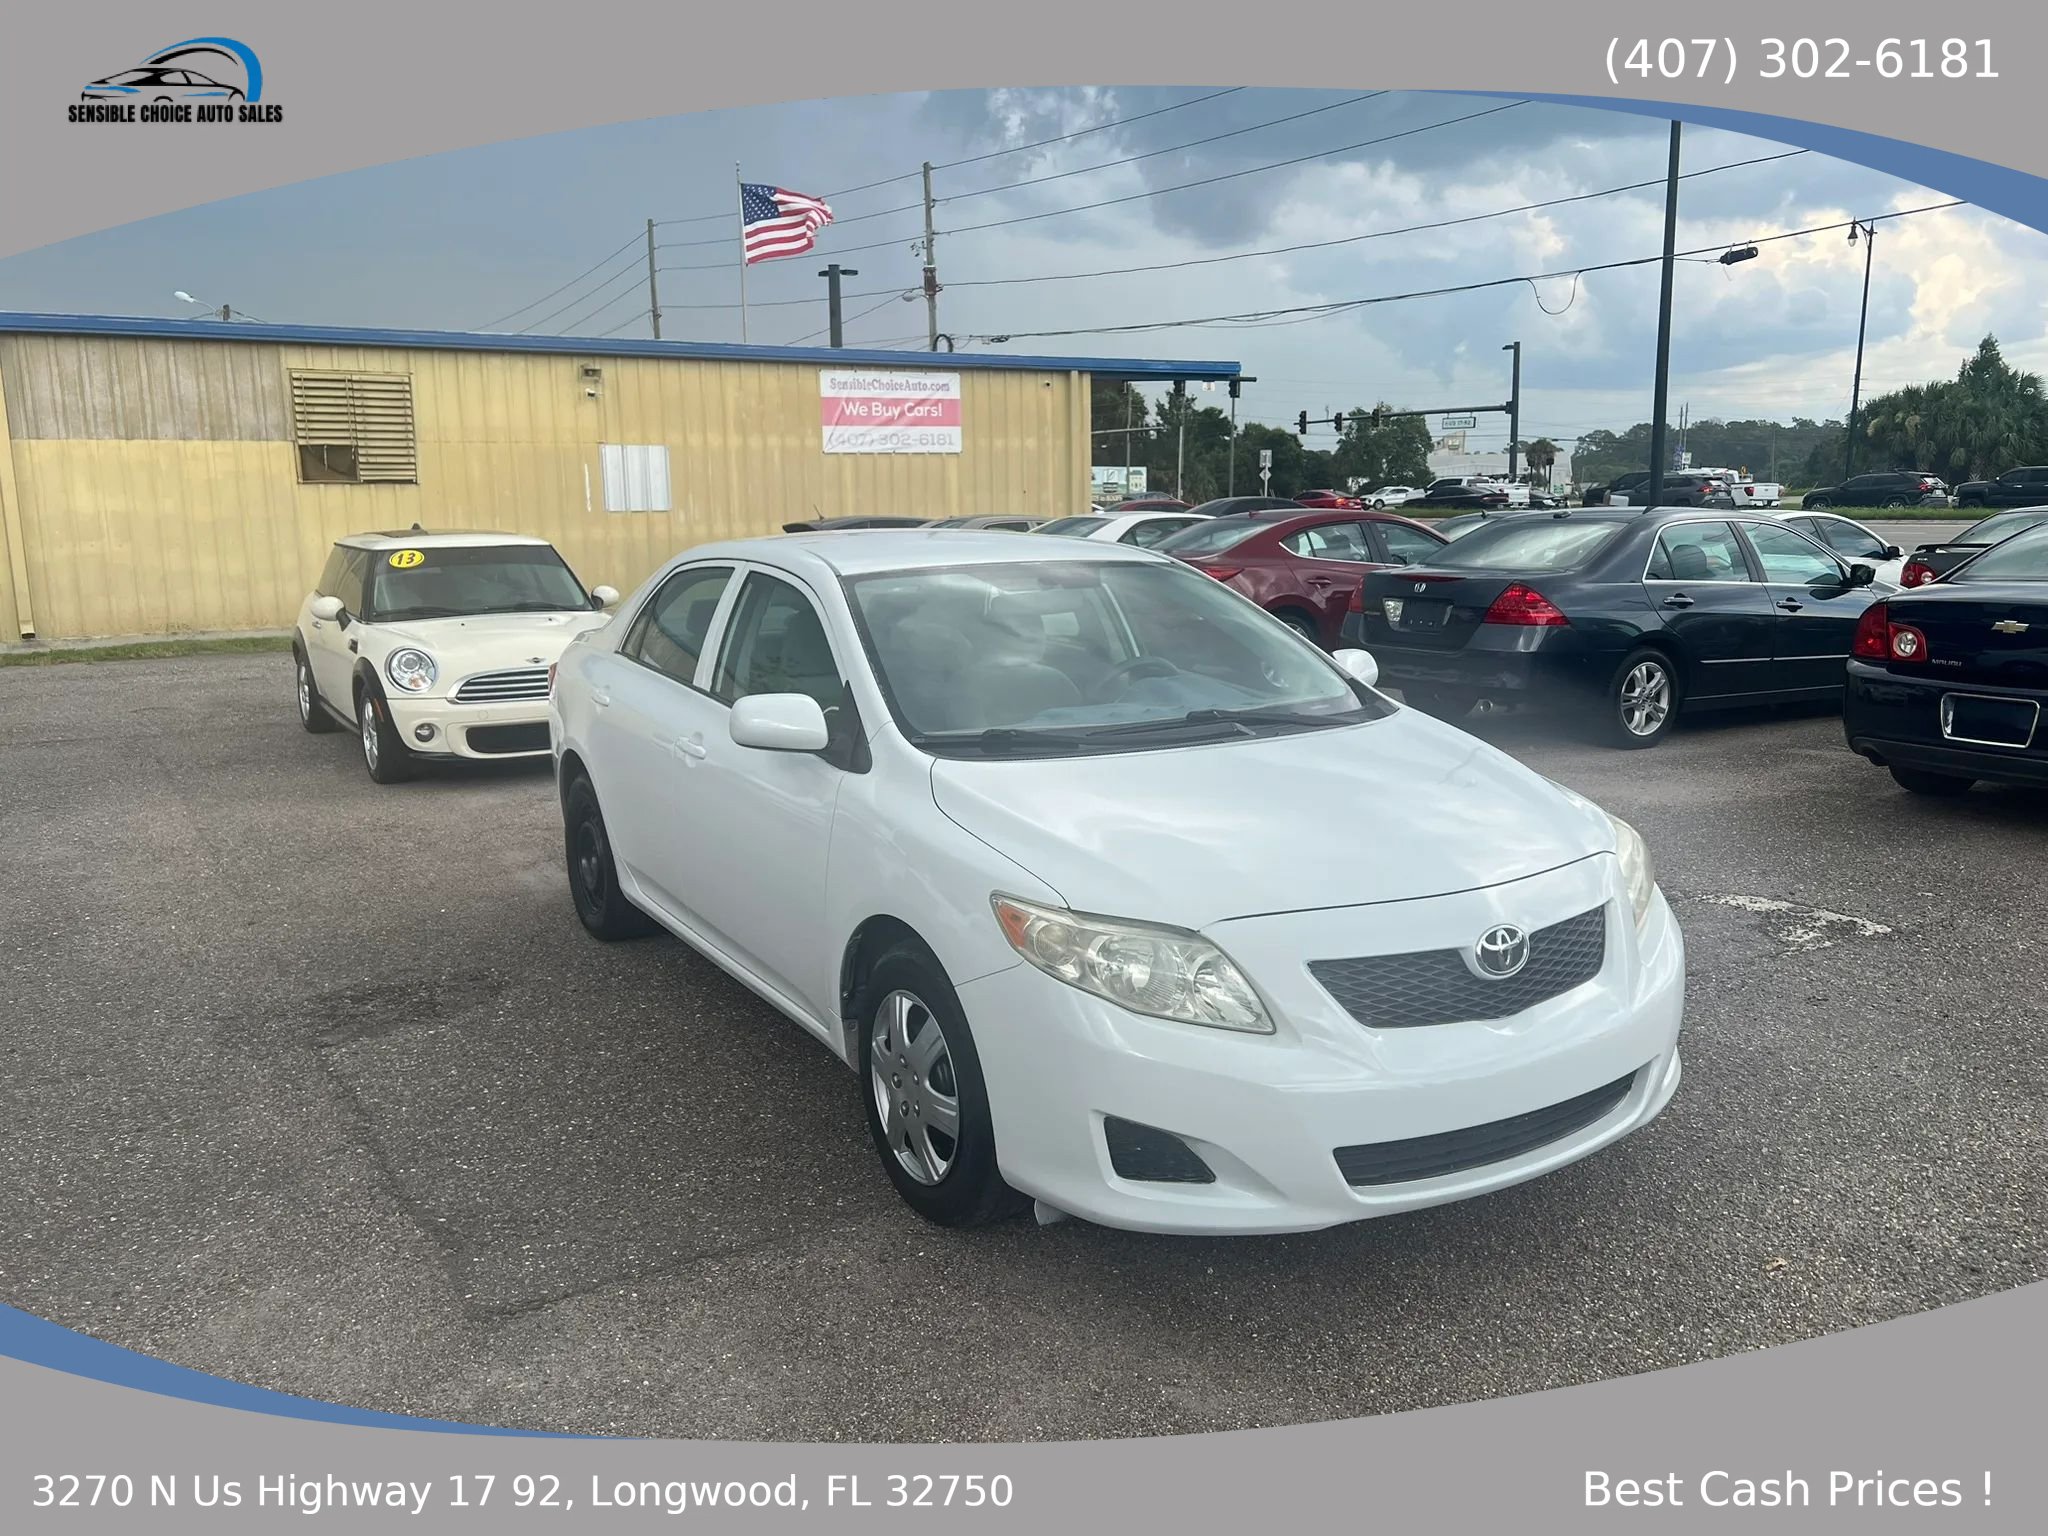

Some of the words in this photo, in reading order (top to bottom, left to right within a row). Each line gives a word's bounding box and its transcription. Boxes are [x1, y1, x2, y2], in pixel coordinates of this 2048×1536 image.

[829, 378, 950, 392] SensibleChoiceAuto.com
[843, 401, 868, 417] We
[872, 402, 901, 420] Buy
[904, 402, 943, 417] Cars!
[396, 552, 416, 566] 13
